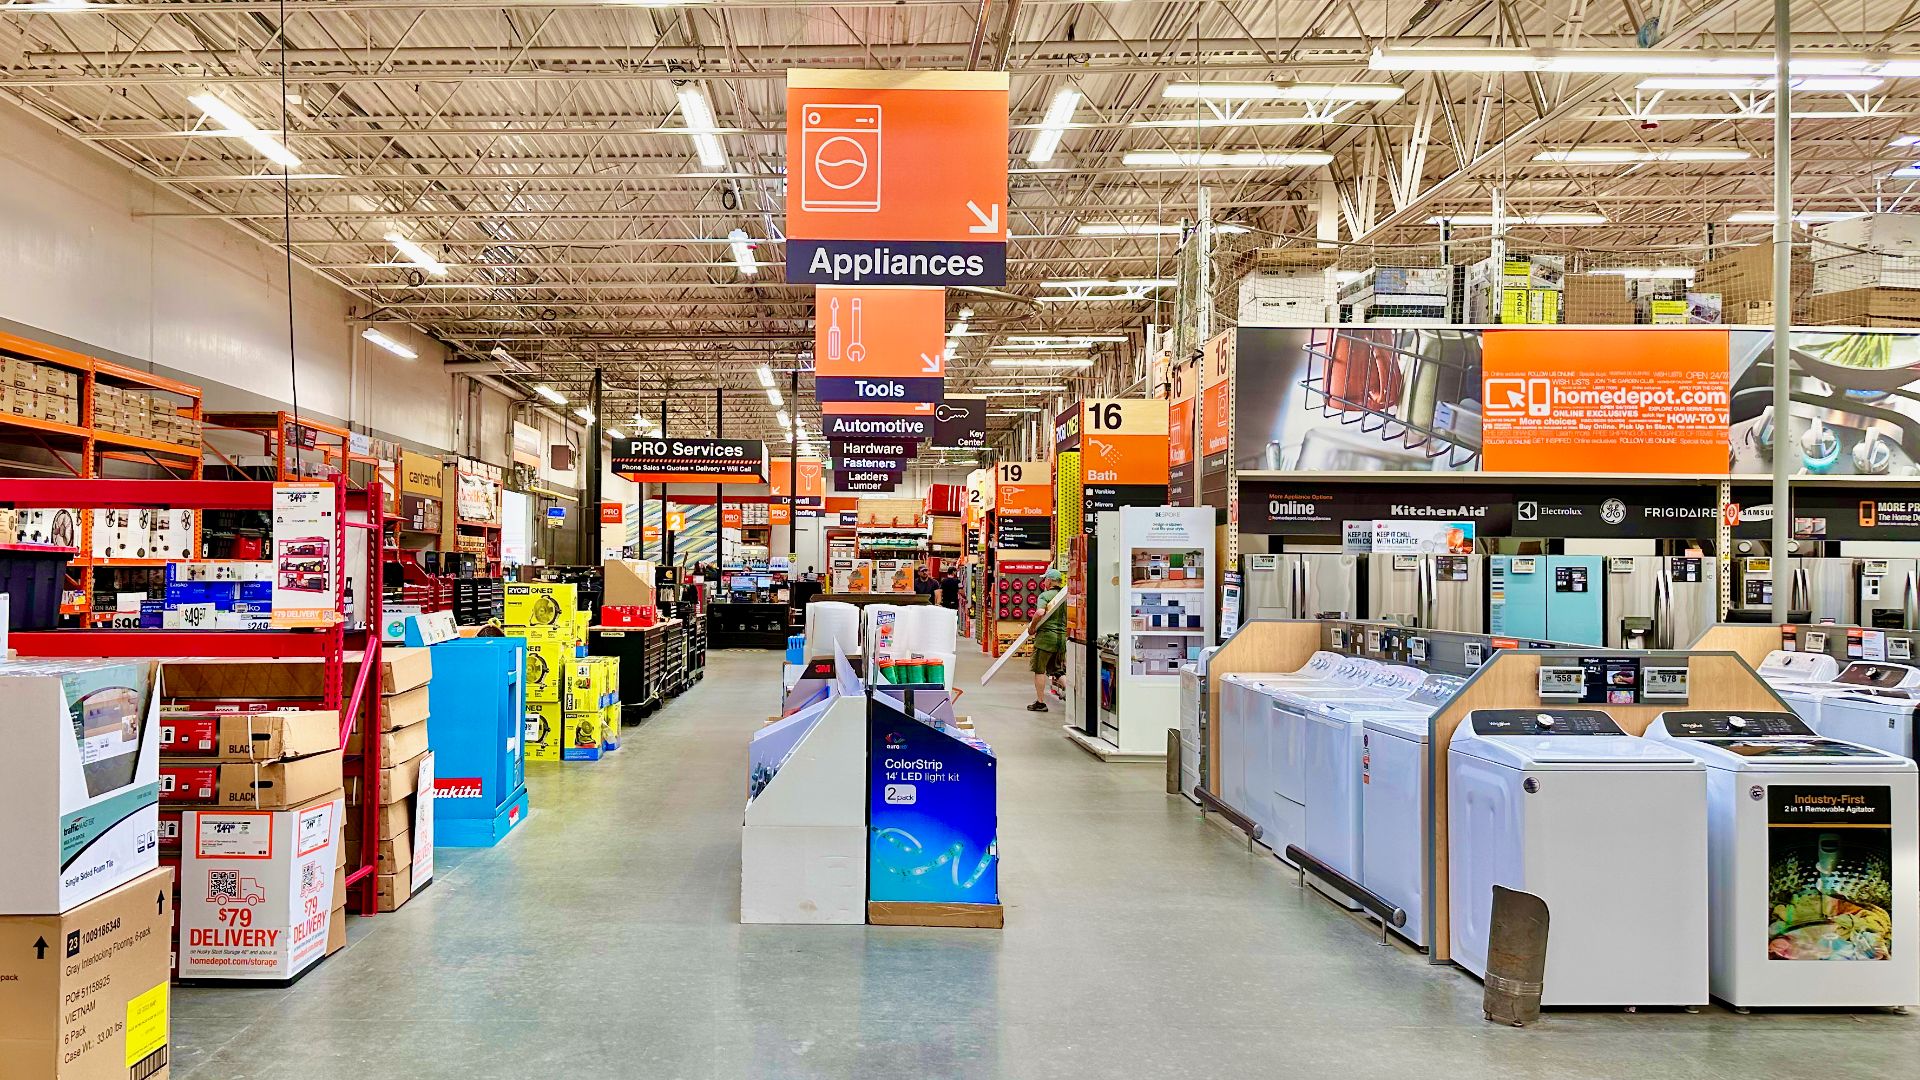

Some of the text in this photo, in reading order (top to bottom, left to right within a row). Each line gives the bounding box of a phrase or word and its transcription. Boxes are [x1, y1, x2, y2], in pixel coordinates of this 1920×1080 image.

[809, 247, 984, 281] Appliances
[1215, 337, 1227, 376] 15
[855, 381, 904, 397] Tools
[1554, 387, 1727, 408] homedepot.com
[1088, 403, 1122, 430] 16
[1667, 414, 1715, 423] HOW-TO
[833, 419, 923, 433] Automotive
[969, 430, 984, 438] Key
[843, 443, 903, 454] Hardware
[958, 438, 984, 446] Center
[631, 442, 743, 457] PRO Services
[843, 458, 896, 468] Fasteners
[848, 472, 889, 481] Ladders
[1000, 464, 1022, 482] 19
[1088, 470, 1117, 481] Bath
[1269, 500, 1315, 515] Online
[1391, 505, 1486, 517] KitchenAid
[1541, 507, 1582, 515] Electrolux
[1645, 508, 1717, 517] FRIGIDAIRE
[1878, 503, 1905, 511] MORE
[671, 515, 681, 529] 2
[287, 610, 320, 618] DELIVERY
[229, 745, 255, 753] BLACK
[885, 759, 943, 771] ColorStrip
[901, 772, 922, 780] LED
[924, 773, 945, 783] light
[948, 773, 960, 781] kit
[229, 793, 256, 801] BLACK
[434, 786, 481, 798] akita
[887, 787, 914, 803] 2 pack
[1795, 795, 1864, 805] Industry-First
[65, 859, 114, 887] Single Sided Foam Tile
[304, 895, 318, 917] $79
[219, 908, 252, 928] $79
[68, 917, 121, 951] 23 1009186348
[294, 912, 327, 944] DELIVERY
[190, 929, 278, 947] DELIVERY
[66, 963, 80, 977] Gray
[82, 946, 112, 970] Interlocking
[190, 957, 277, 967] homedepot.com/storage
[65, 974, 111, 1006] PO# 51158925
[65, 999, 96, 1025] VIETNAM
[64, 1025, 86, 1045] 6 Pack
[64, 1048, 81, 1064] Case
[96, 1028, 113, 1045] 33.00
